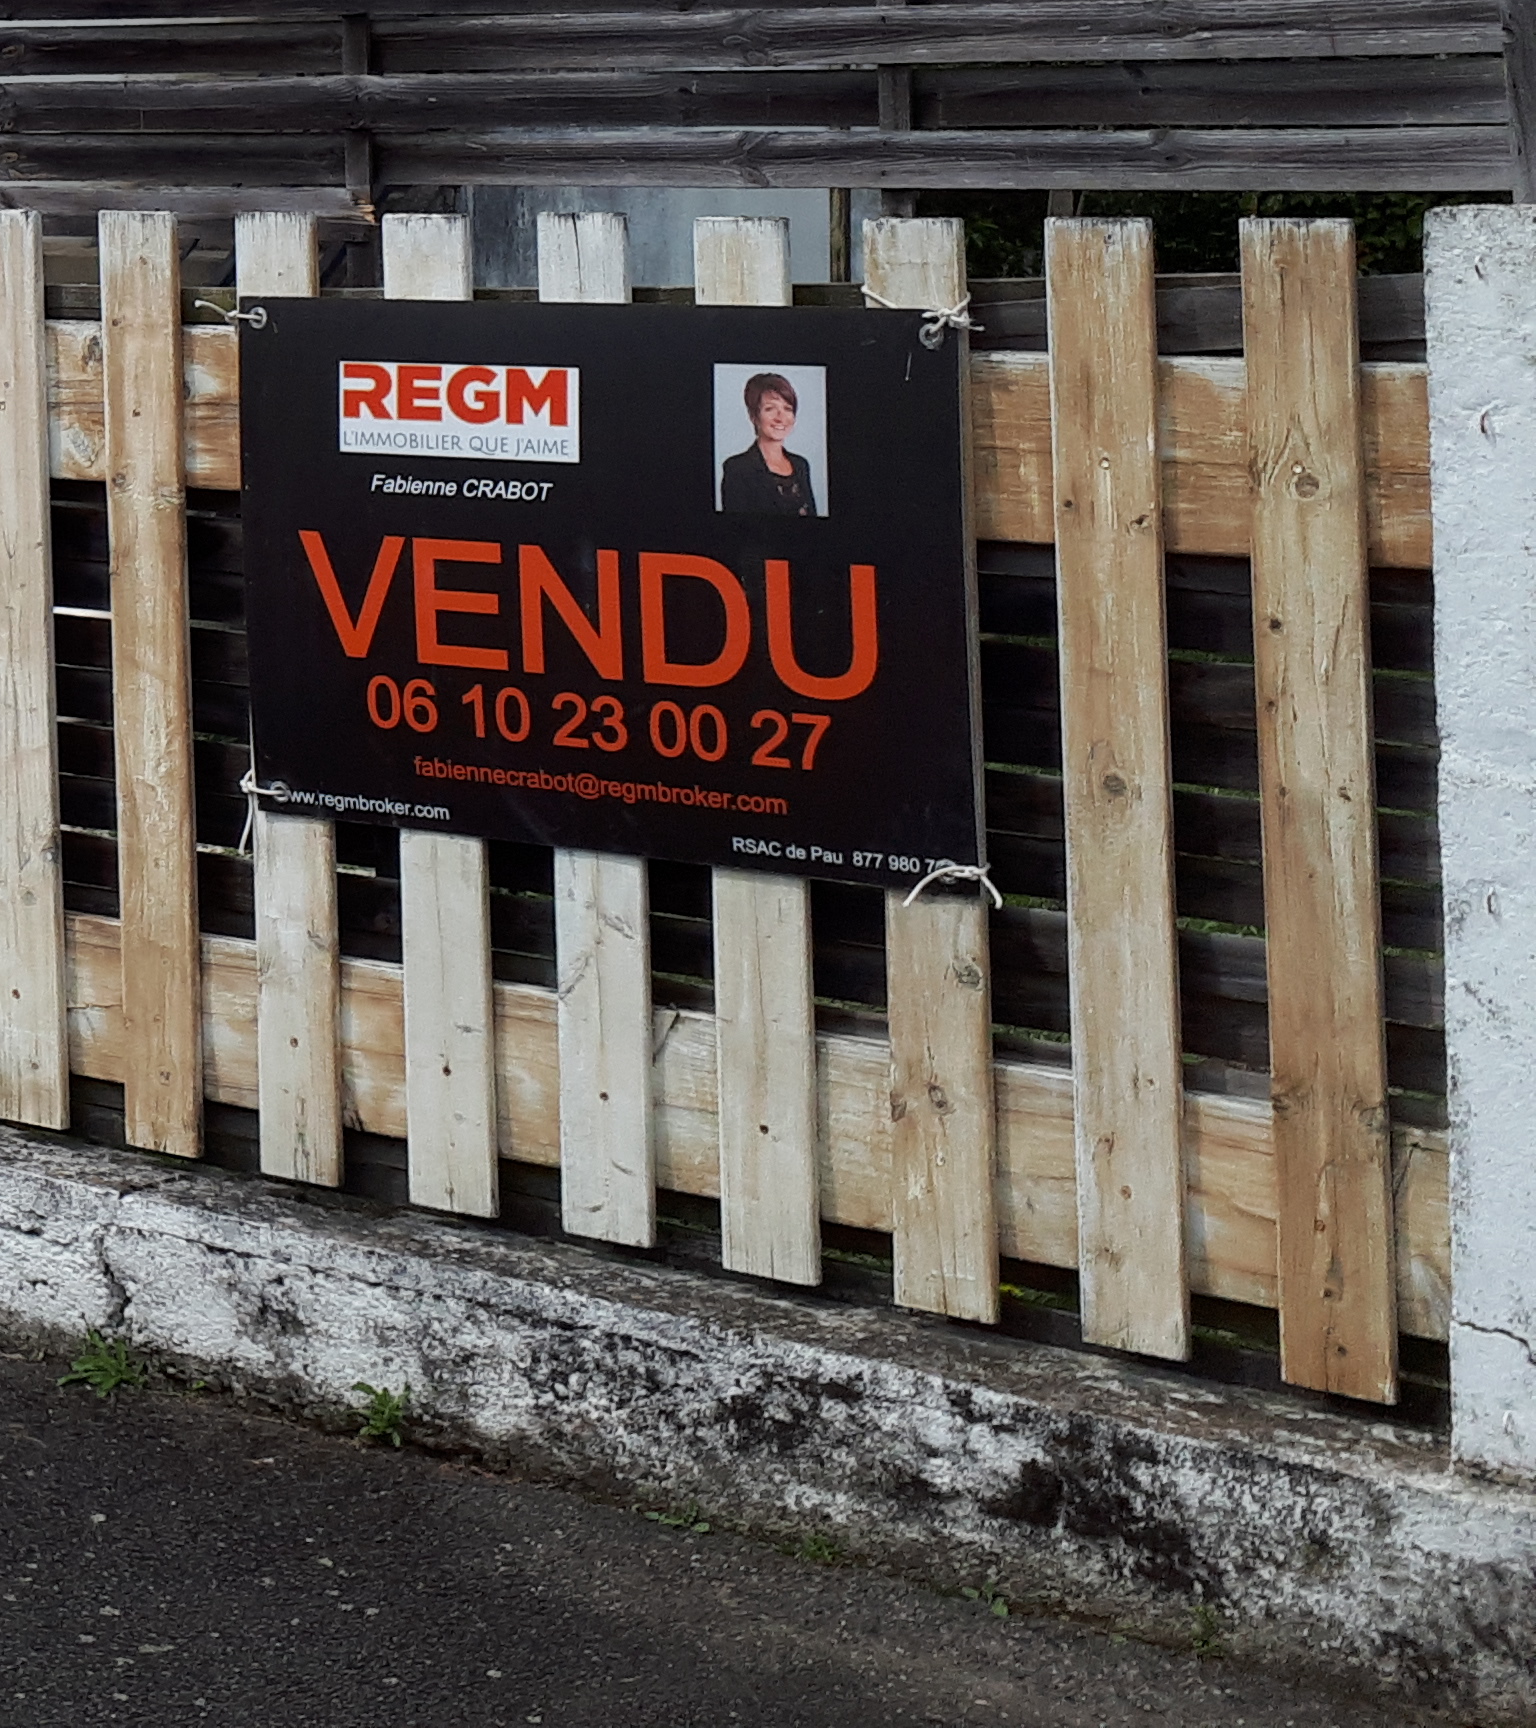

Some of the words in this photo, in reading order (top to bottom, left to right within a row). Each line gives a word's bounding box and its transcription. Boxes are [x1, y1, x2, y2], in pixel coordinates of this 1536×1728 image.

[343, 363, 568, 427] REGM
[343, 430, 463, 451] L'IMMOBILIER
[469, 436, 509, 456] QUE
[515, 437, 569, 457] J'AIME
[371, 474, 457, 496] Fabienne
[462, 479, 553, 501] CRABOT
[298, 530, 879, 701] VENDU
[366, 675, 438, 733] 06
[461, 684, 531, 742] 10
[551, 692, 629, 752] 23
[649, 700, 728, 762] 00
[750, 709, 831, 771] 27
[282, 789, 450, 820] ww.regmbroker.com
[413, 756, 788, 815] fabiennecrabot@regmbroker.com
[731, 836, 782, 857] RSAC
[785, 844, 807, 860] de
[810, 846, 843, 865] Pau
[852, 850, 883, 870] 877
[888, 856, 920, 873] 980
